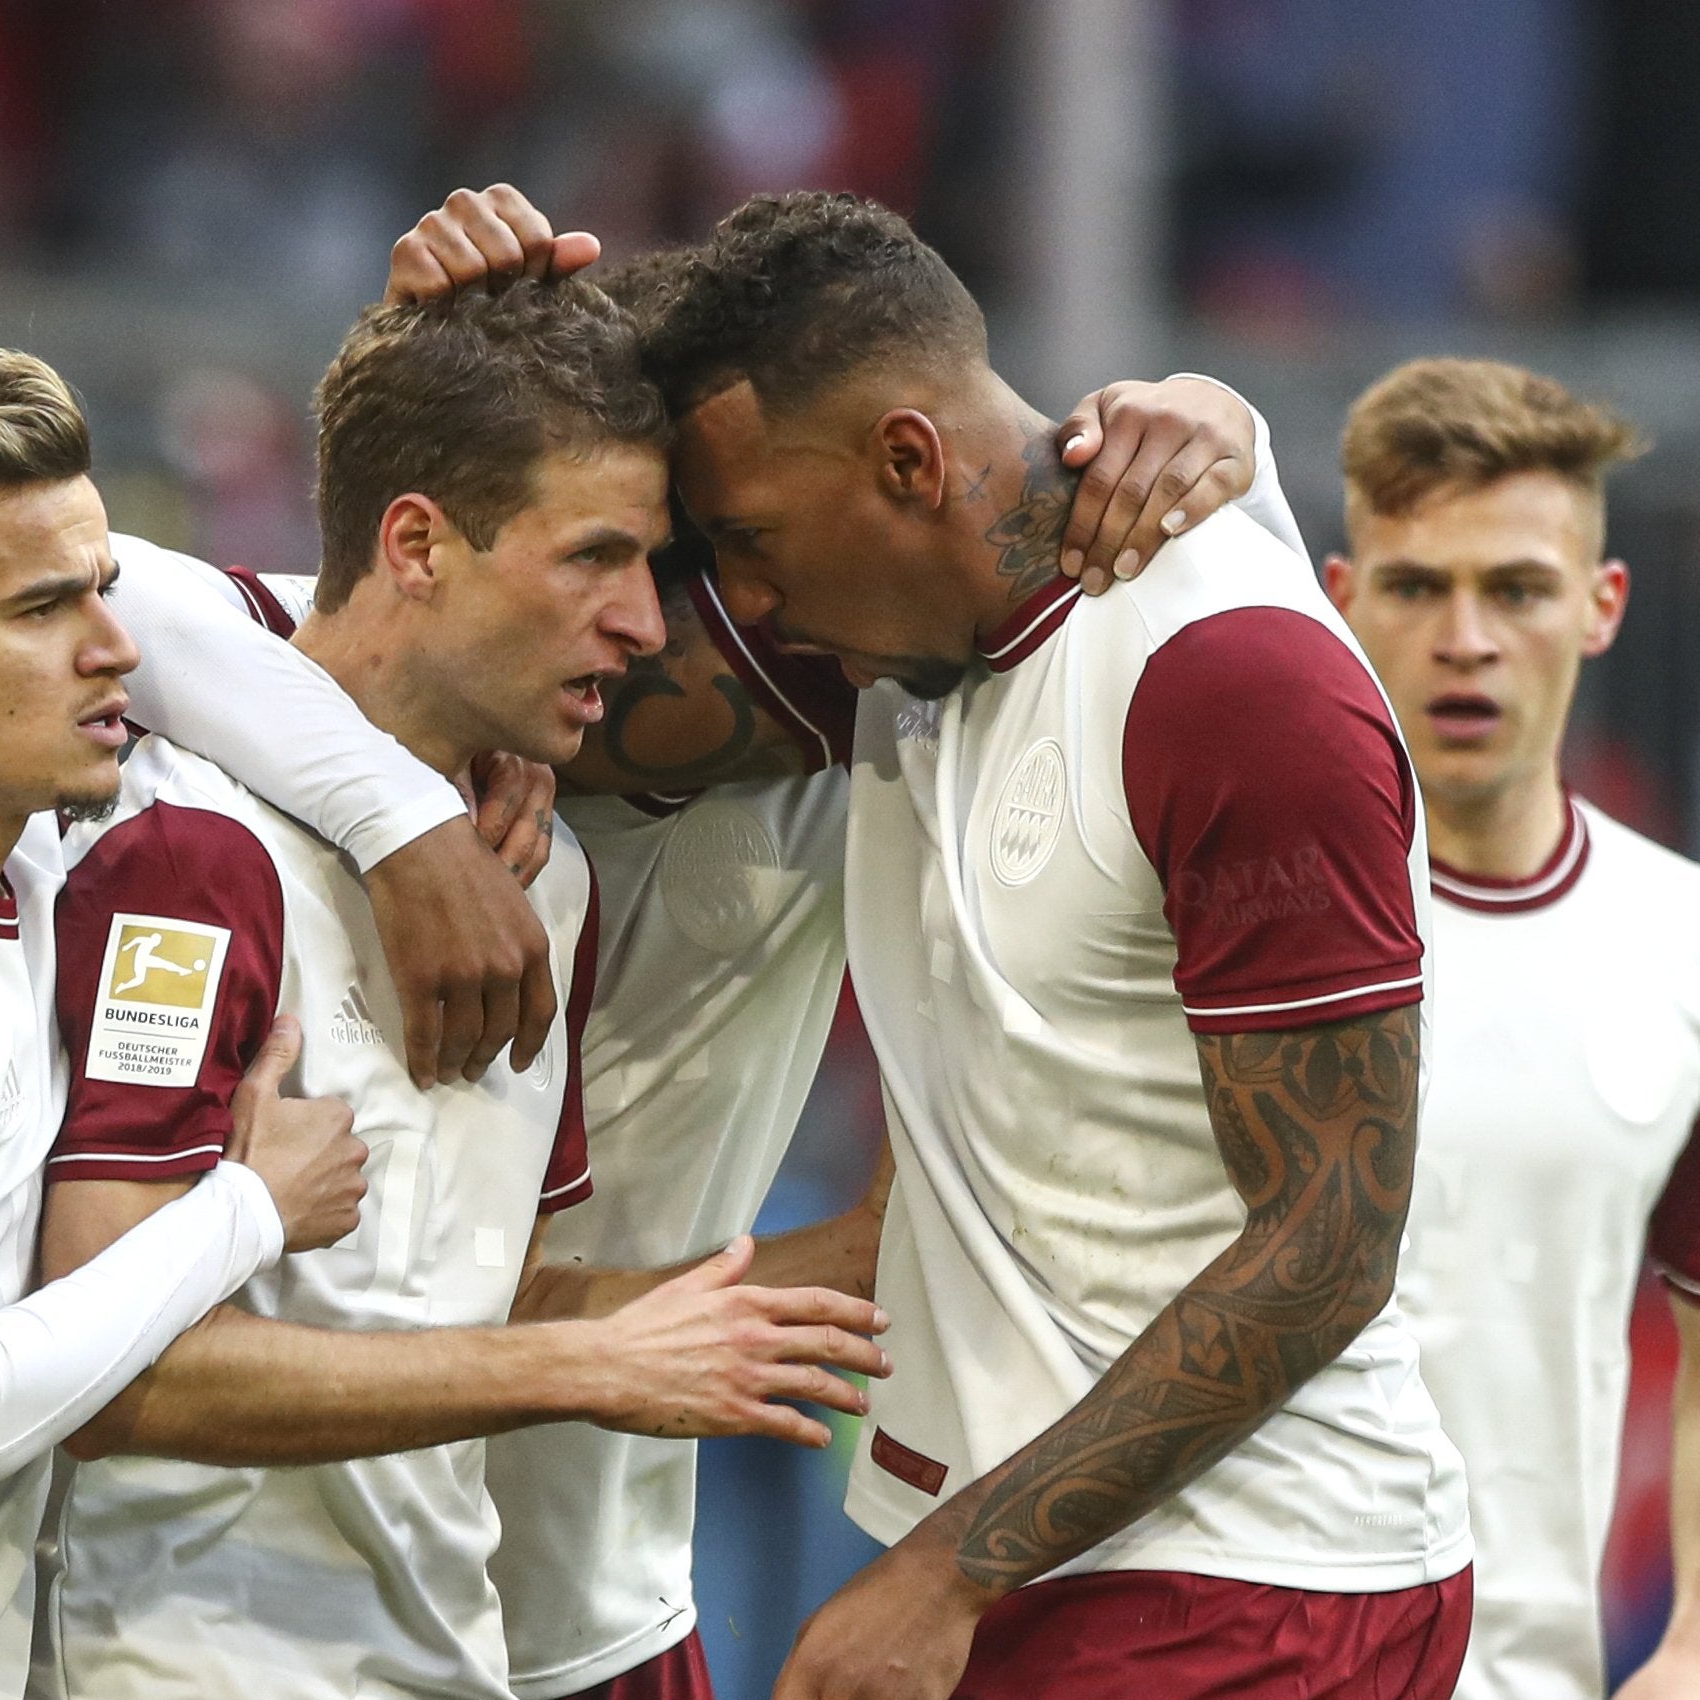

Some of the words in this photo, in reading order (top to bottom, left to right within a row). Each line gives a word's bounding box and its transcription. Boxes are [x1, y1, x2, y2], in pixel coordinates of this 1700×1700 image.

[105, 1008, 199, 1029] BUNDESLIGA
[118, 1042, 178, 1056] DEUTSCHER
[99, 1050, 192, 1067] FUSSBALLMEISTER
[118, 1062, 172, 1075] 2018/2019
